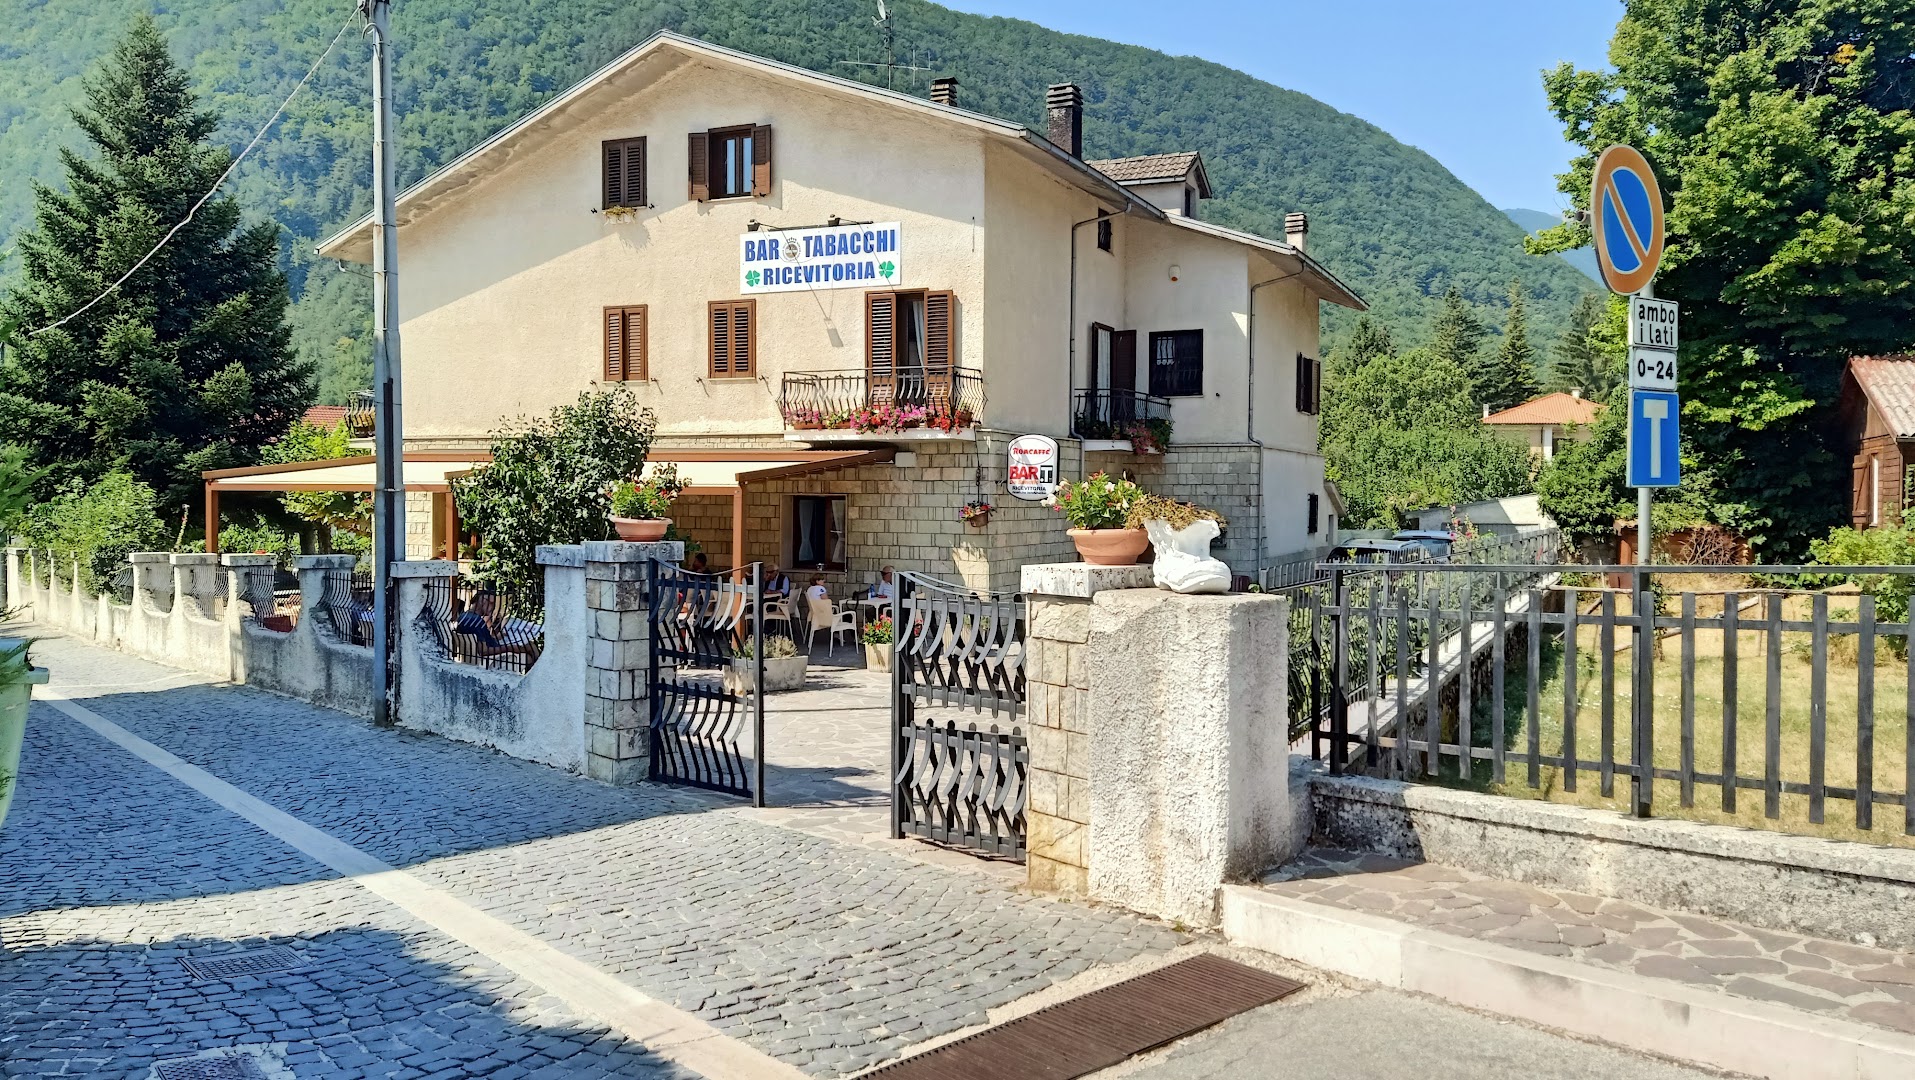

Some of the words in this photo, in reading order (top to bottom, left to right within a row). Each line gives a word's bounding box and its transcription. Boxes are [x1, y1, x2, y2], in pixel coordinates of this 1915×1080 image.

[745, 238, 779, 262] BAR
[803, 229, 896, 258] TABACCHI
[763, 261, 875, 286] RICEVITORIA
[1638, 303, 1675, 324] ambo
[1640, 323, 1644, 343] i
[1649, 324, 1674, 346] lati
[1637, 358, 1674, 380] 0-24
[1009, 466, 1039, 480] BAR
